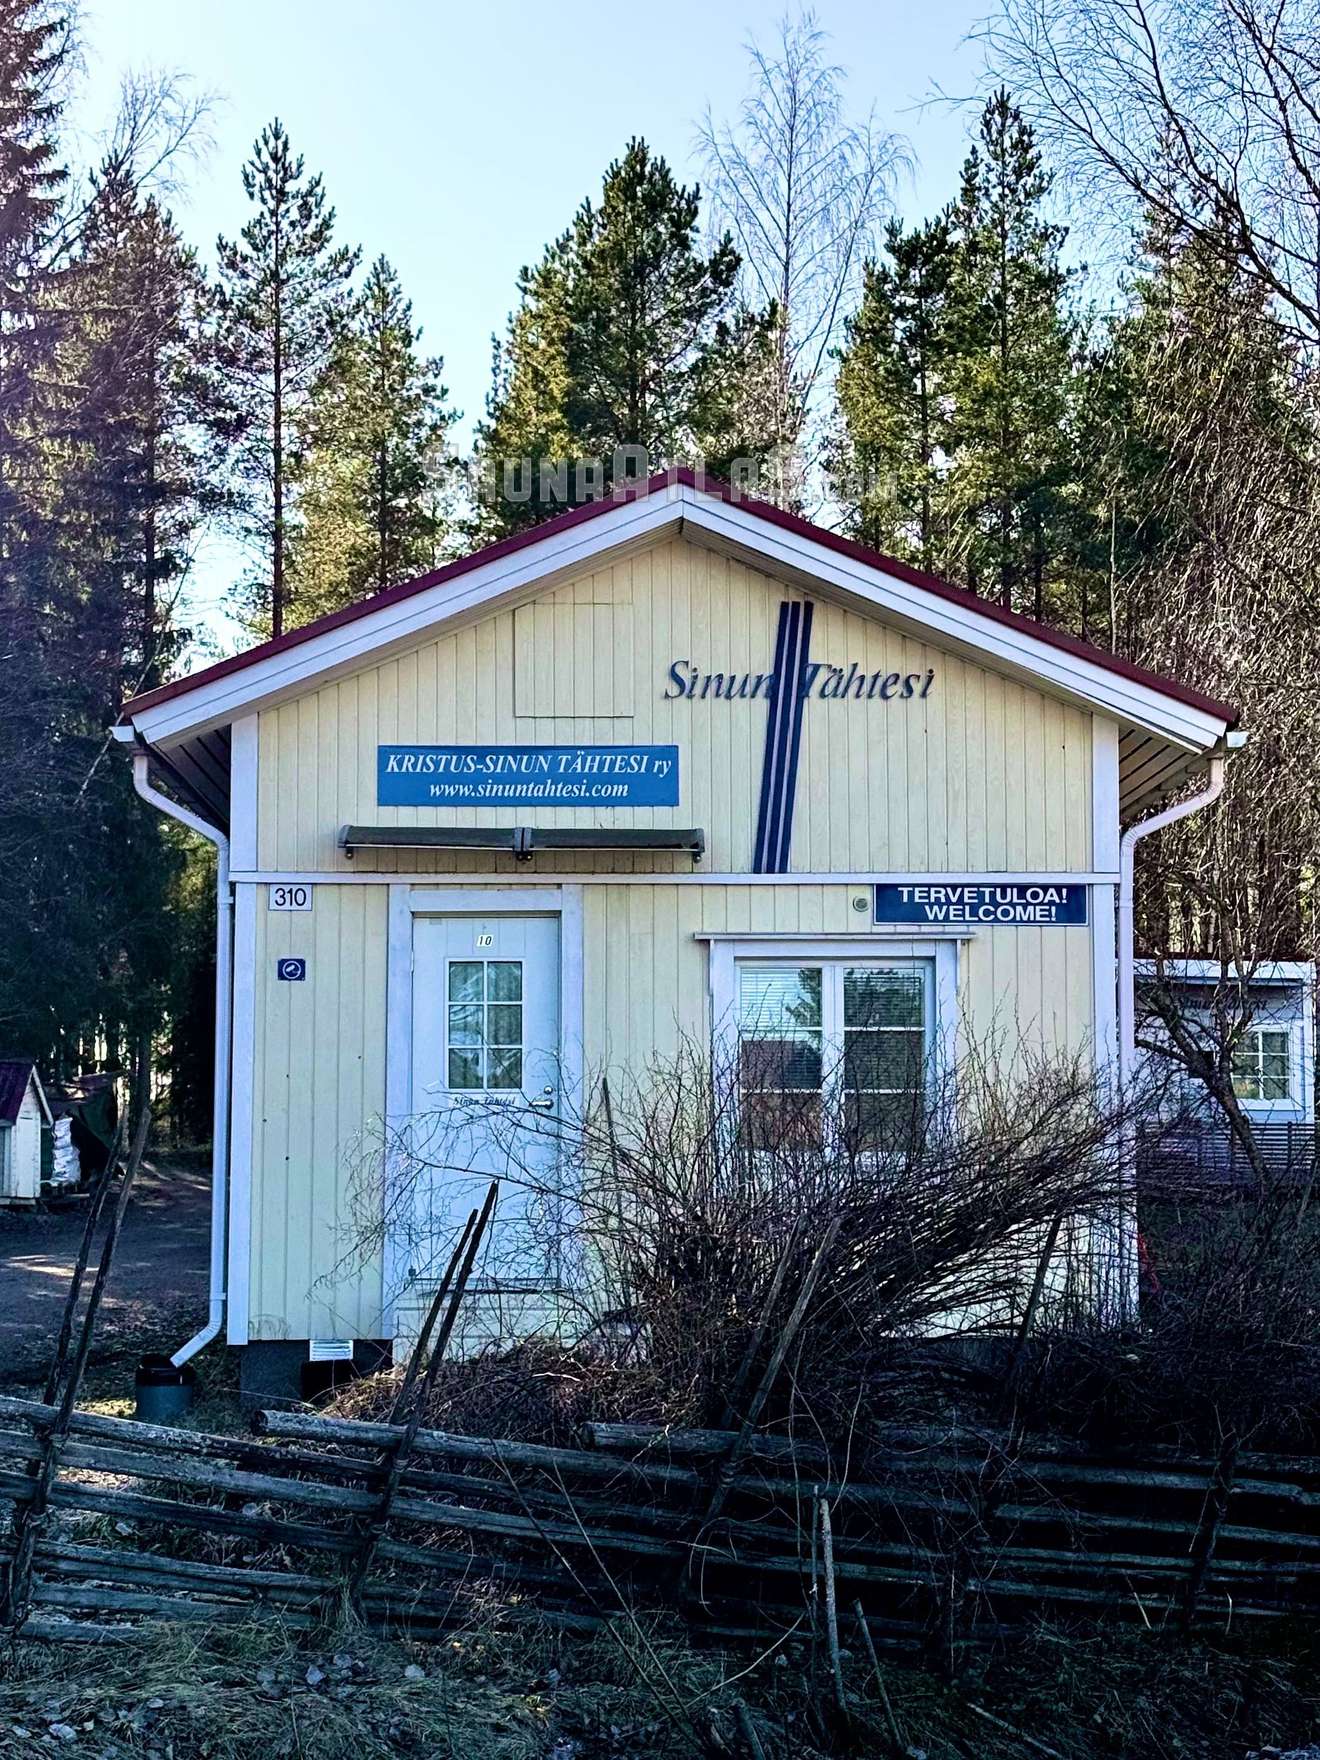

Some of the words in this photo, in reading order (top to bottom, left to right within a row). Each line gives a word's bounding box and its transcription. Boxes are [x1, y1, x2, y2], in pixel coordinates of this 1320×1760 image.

[664, 660, 775, 700] Sinun
[803, 662, 935, 700] Tähtesi
[385, 754, 551, 773] KRISTUS-SINUN
[558, 750, 649, 773] TÄHTESI
[653, 759, 671, 777] ry
[429, 779, 628, 797] www.sinuntahtesi.com
[275, 888, 306, 906] 310
[898, 887, 1067, 903] TERVETULOA!
[925, 905, 1056, 921] WELCOME!
